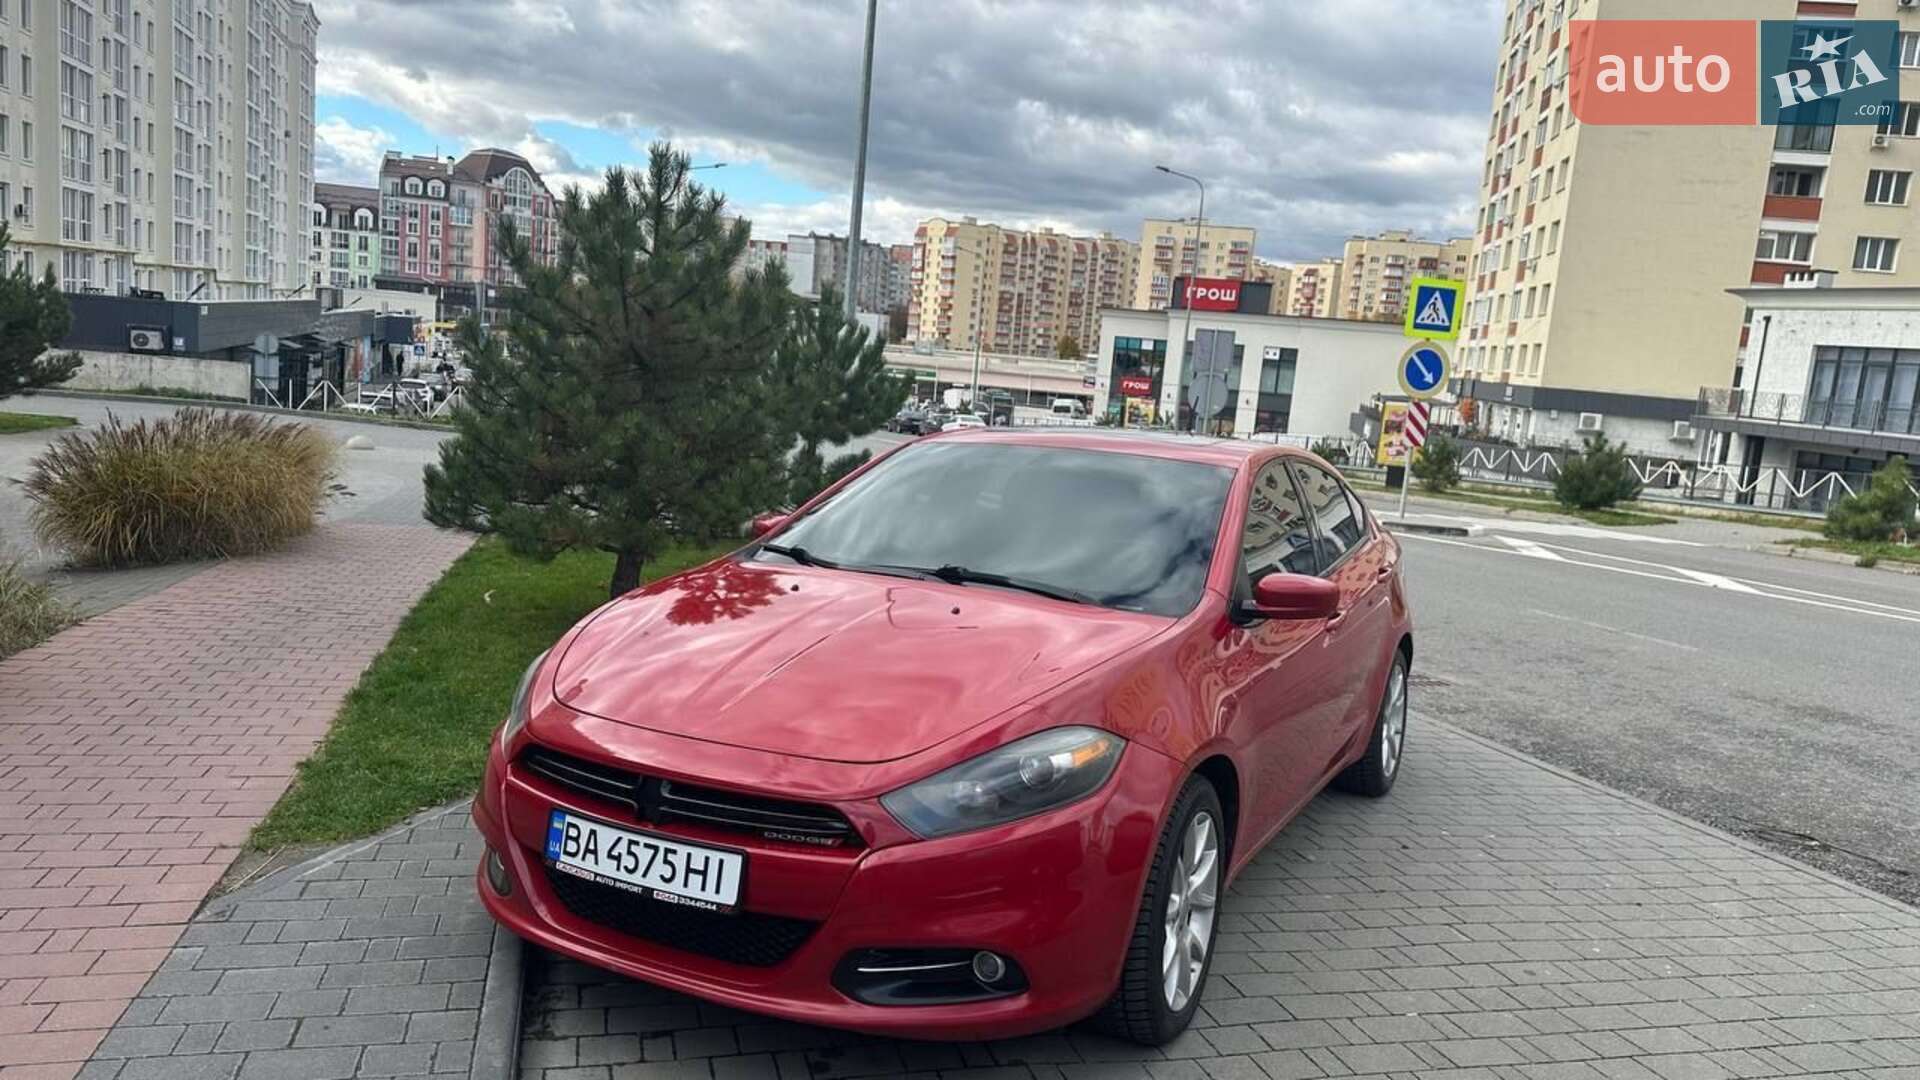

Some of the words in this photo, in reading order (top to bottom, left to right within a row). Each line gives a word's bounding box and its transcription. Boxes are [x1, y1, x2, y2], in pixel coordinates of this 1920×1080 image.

[1186, 286, 1236, 301] ГРОШ
[1122, 380, 1150, 390] ГРОШ
[595, 875, 615, 886] AUTO
[615, 880, 643, 894] IMPORT
